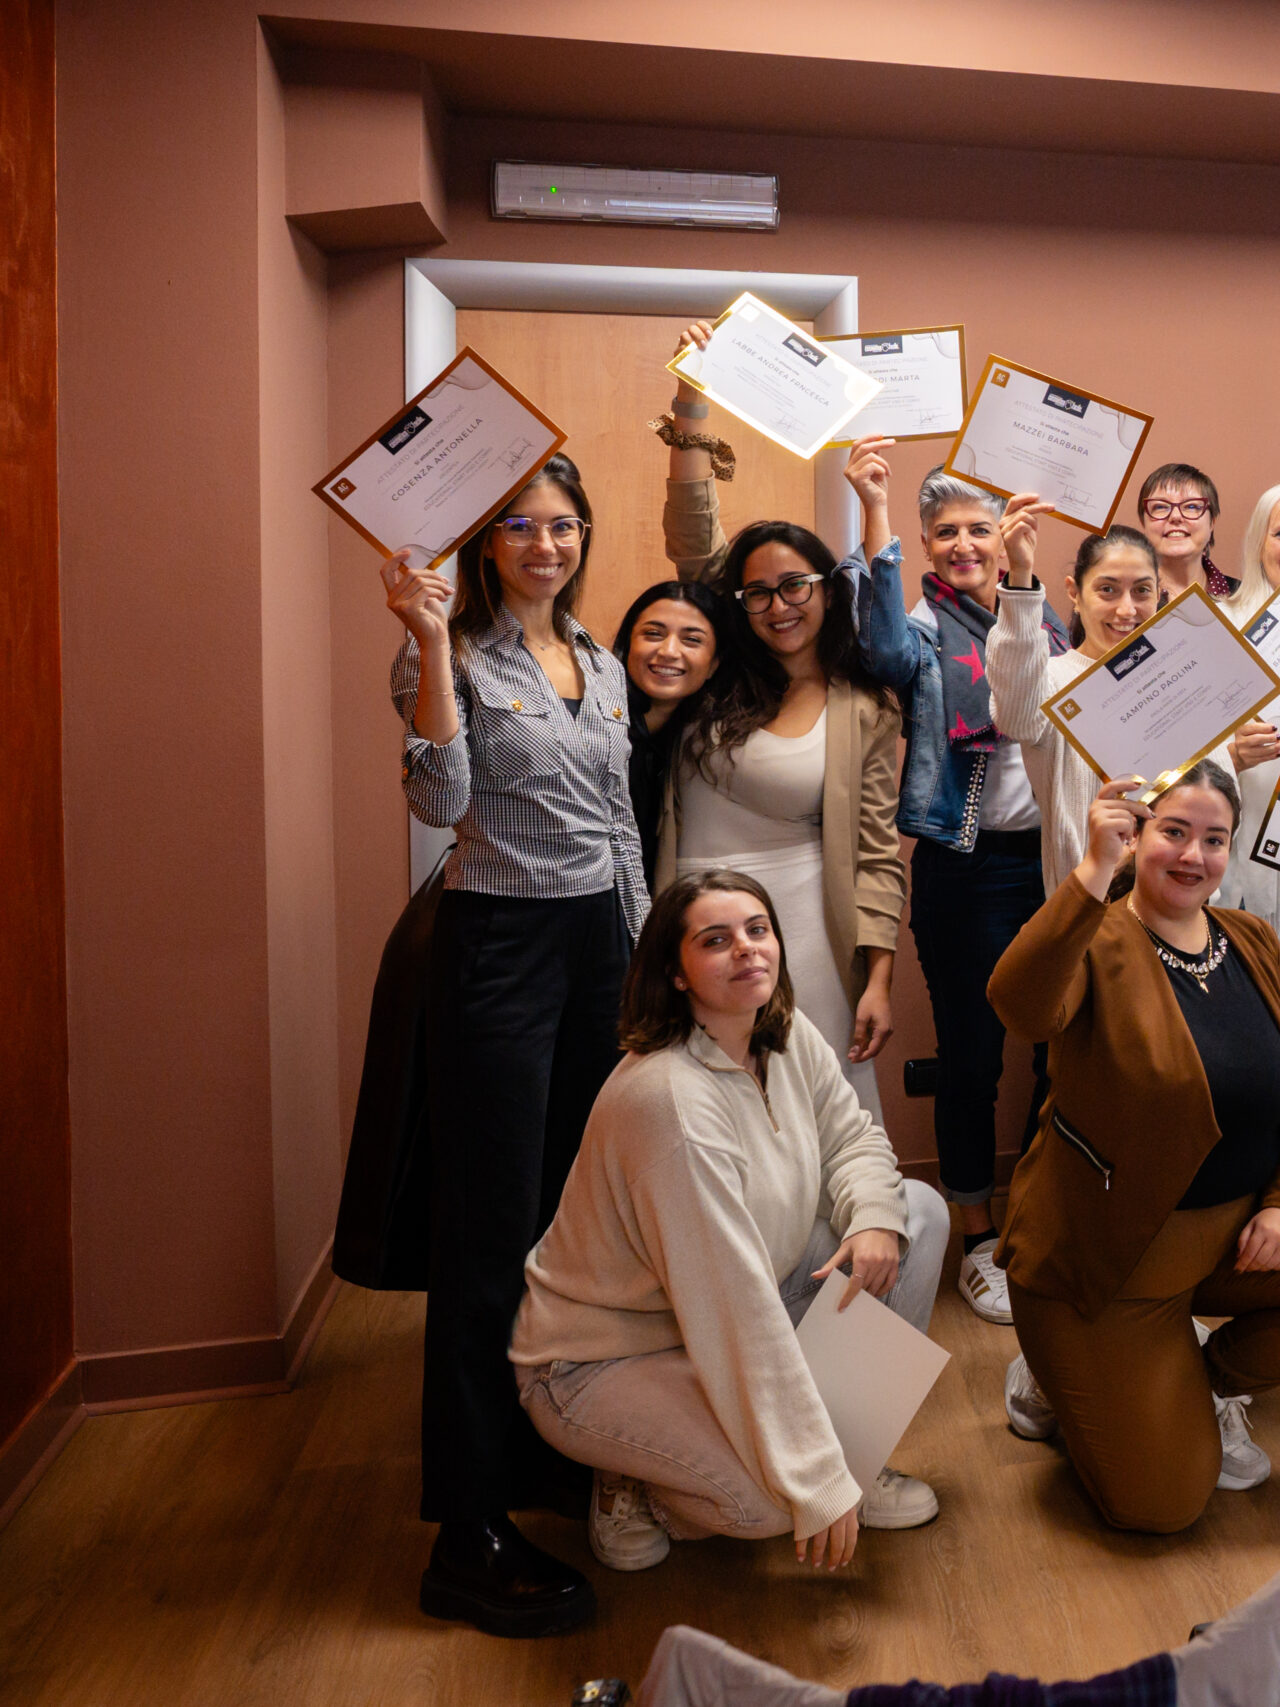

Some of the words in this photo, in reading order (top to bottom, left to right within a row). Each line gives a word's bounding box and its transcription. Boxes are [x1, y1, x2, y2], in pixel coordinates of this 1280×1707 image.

[890, 373, 920, 383] MARTA
[390, 462, 434, 503] COSENZA
[432, 417, 484, 464] ANTONELLA
[1012, 420, 1046, 439] MAZZEI
[1047, 434, 1090, 457] BARBARA
[1119, 688, 1161, 724] SAMPINO
[1159, 659, 1198, 691] PAOLINA
